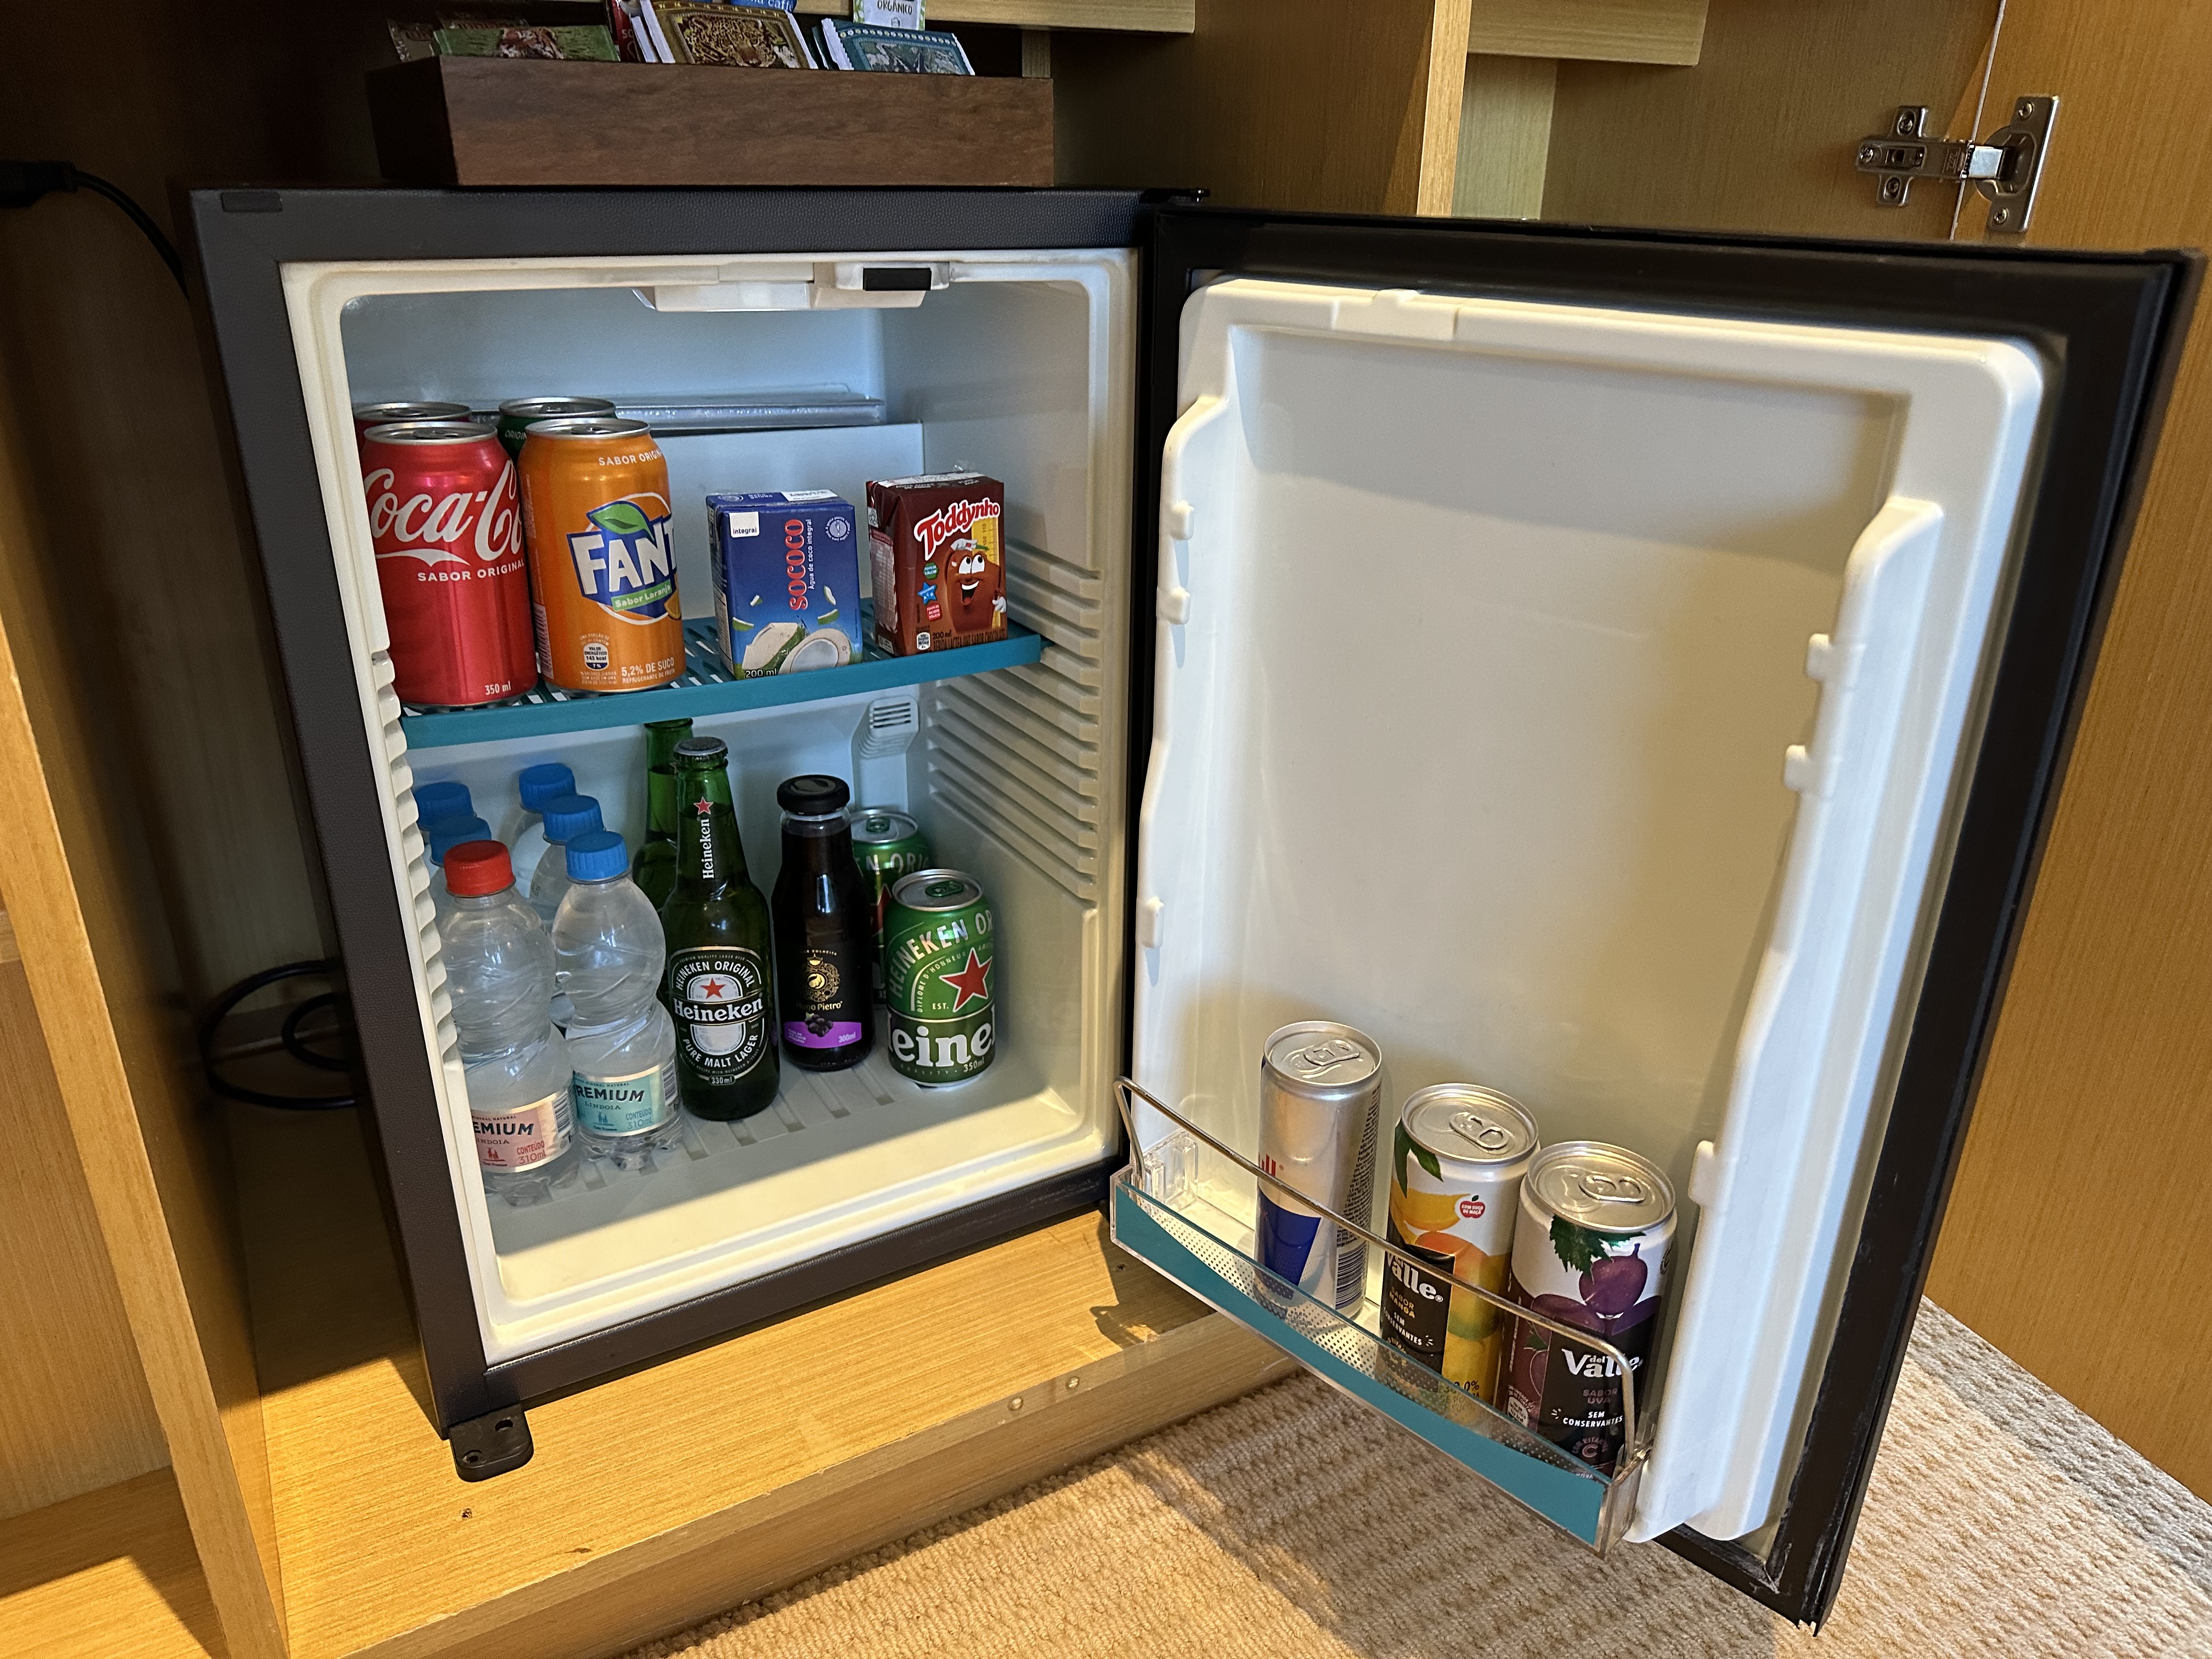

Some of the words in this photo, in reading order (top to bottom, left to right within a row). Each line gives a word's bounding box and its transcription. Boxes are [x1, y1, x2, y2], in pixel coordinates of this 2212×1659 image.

[599, 454, 637, 466] SABOR
[732, 526, 758, 535] integral
[805, 519, 814, 545] integral
[916, 498, 1000, 558] Toddynho
[417, 571, 471, 582] SABOR
[477, 558, 524, 579] ORIGINAL
[785, 518, 809, 611] SOCOCO
[808, 563, 814, 572] de
[808, 573, 816, 590] Água
[615, 595, 643, 607] Sabor
[645, 584, 671, 599] Laranja
[621, 665, 644, 678] 5,2%
[646, 662, 656, 673] DE
[657, 657, 675, 671] SUCO
[745, 669, 764, 679] 200
[766, 668, 777, 676] ml
[622, 674, 658, 684] REFRIGERANTE
[484, 683, 500, 696] 350
[501, 680, 511, 692] ml
[700, 818, 715, 879] Heineken
[889, 919, 969, 998] HEINEKEN
[675, 961, 710, 990] HEINEKEN
[714, 961, 755, 988] ORIGINAL
[917, 980, 926, 1013] DIPLOME
[674, 997, 764, 1022] Heineken
[817, 1002, 842, 1011] Pietro
[838, 1032, 856, 1043] 300ml
[888, 1012, 994, 1067] eine
[682, 1039, 702, 1062] PURE
[704, 1057, 731, 1068] MALT
[735, 1034, 758, 1062] LAGER
[963, 1057, 985, 1073] 350ml
[585, 1101, 622, 1110] LINDOIA
[625, 1107, 652, 1121] CONTEÚDO
[517, 1141, 545, 1155] CONTEÚDO
[1389, 1290, 1415, 1319] MANGA
[1391, 1286, 1414, 1310] SABOR
[1393, 1312, 1406, 1326] SEM
[1589, 1355, 1606, 1363] del
[1583, 1388, 1618, 1397] SABOR
[1563, 1415, 1623, 1427] CONSERVANTES
[1588, 1410, 1606, 1419] SEM
